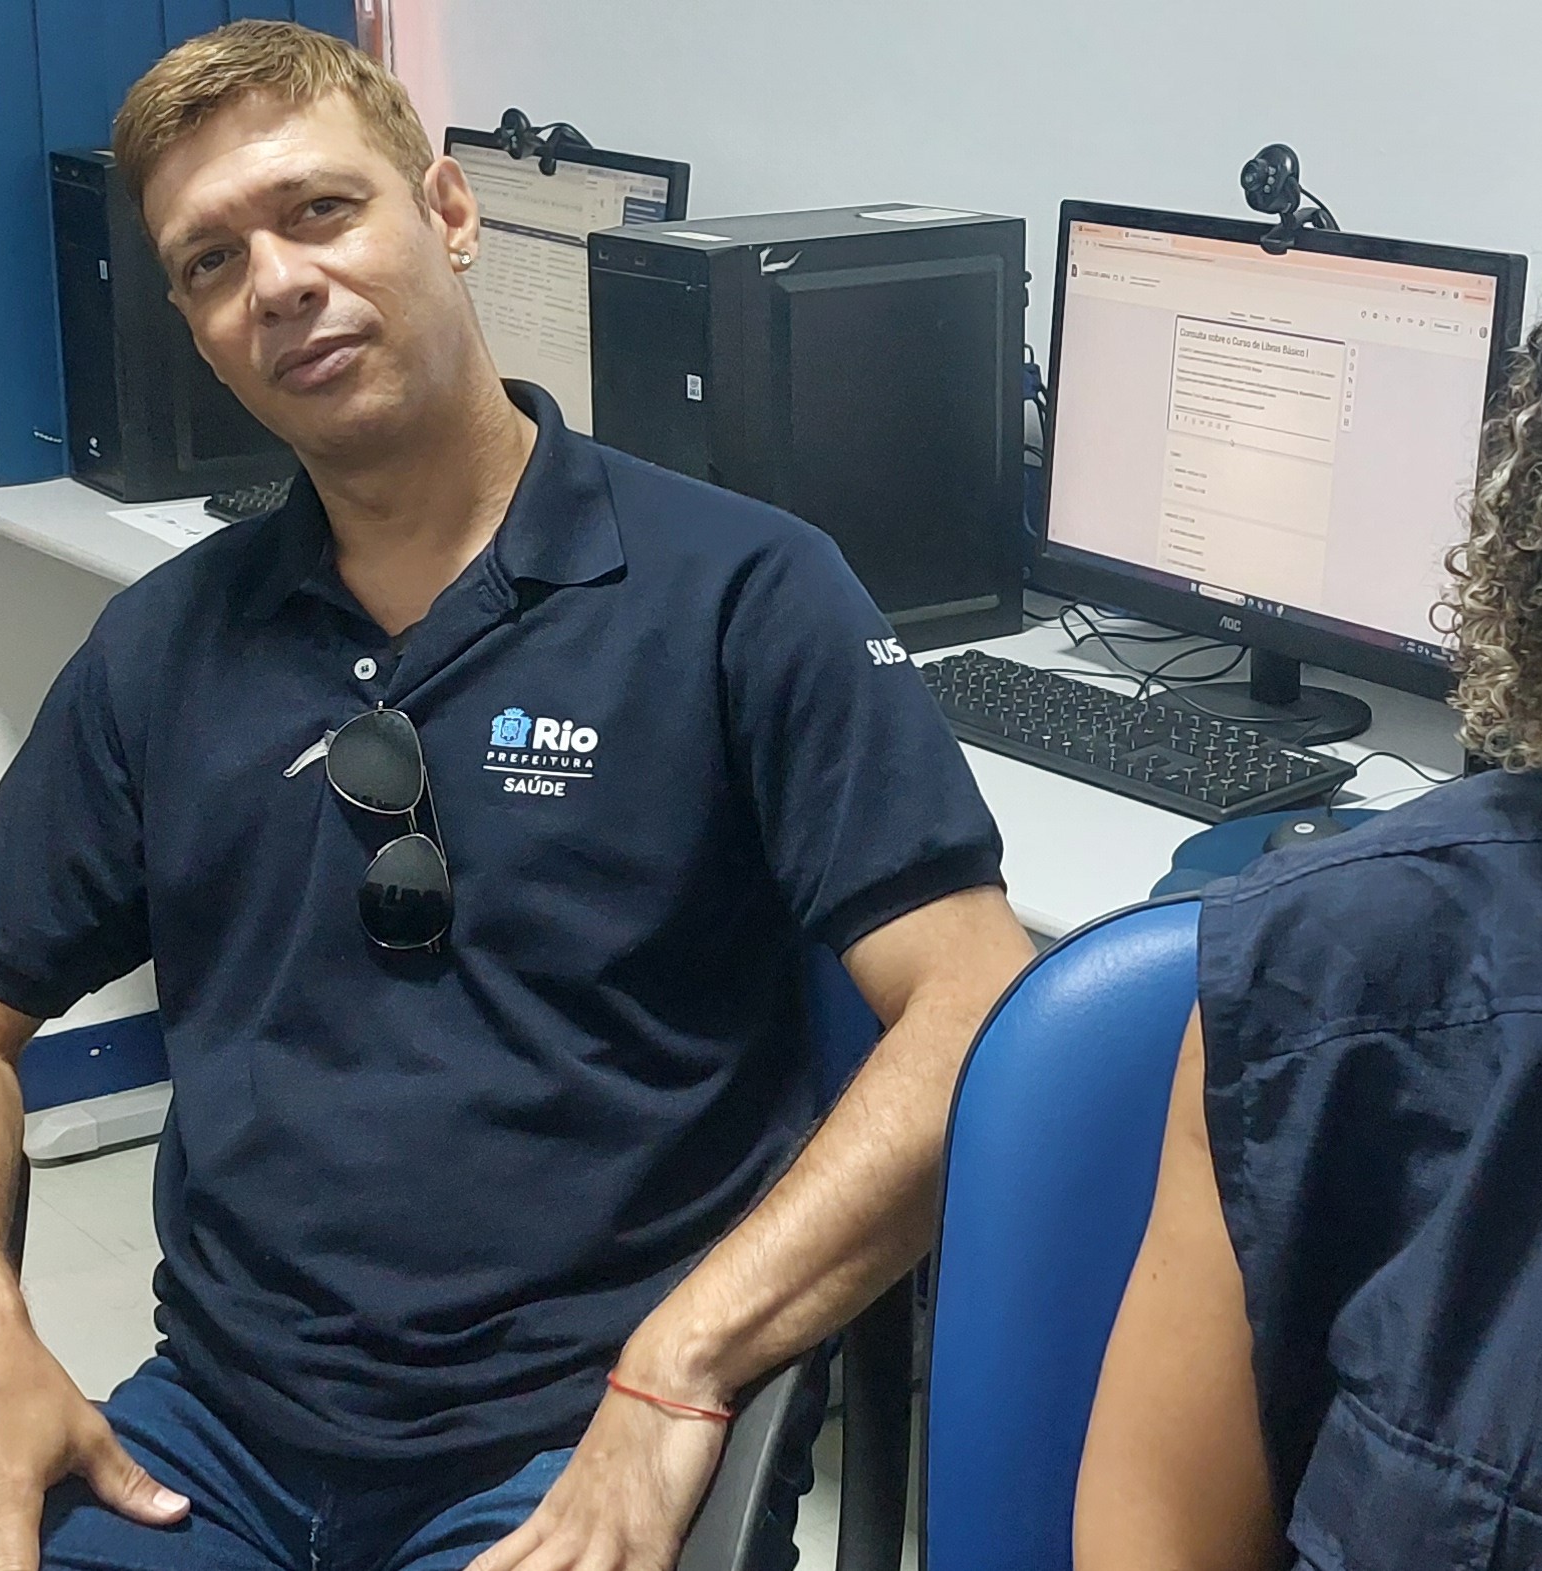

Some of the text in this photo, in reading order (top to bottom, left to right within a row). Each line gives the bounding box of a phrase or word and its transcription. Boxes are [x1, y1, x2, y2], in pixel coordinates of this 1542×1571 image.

[1179, 326, 1207, 341] Consulta
[1207, 331, 1225, 344] sobre
[1231, 335, 1251, 348] Curso
[1251, 338, 1261, 350] de
[1261, 340, 1281, 353] Libras
[1281, 343, 1305, 358] Básico
[1219, 615, 1242, 632] AOC
[865, 637, 908, 666] SUS
[532, 717, 599, 753] Rio
[486, 751, 594, 769] PREFEITURA
[502, 775, 567, 797] SAÚDE
